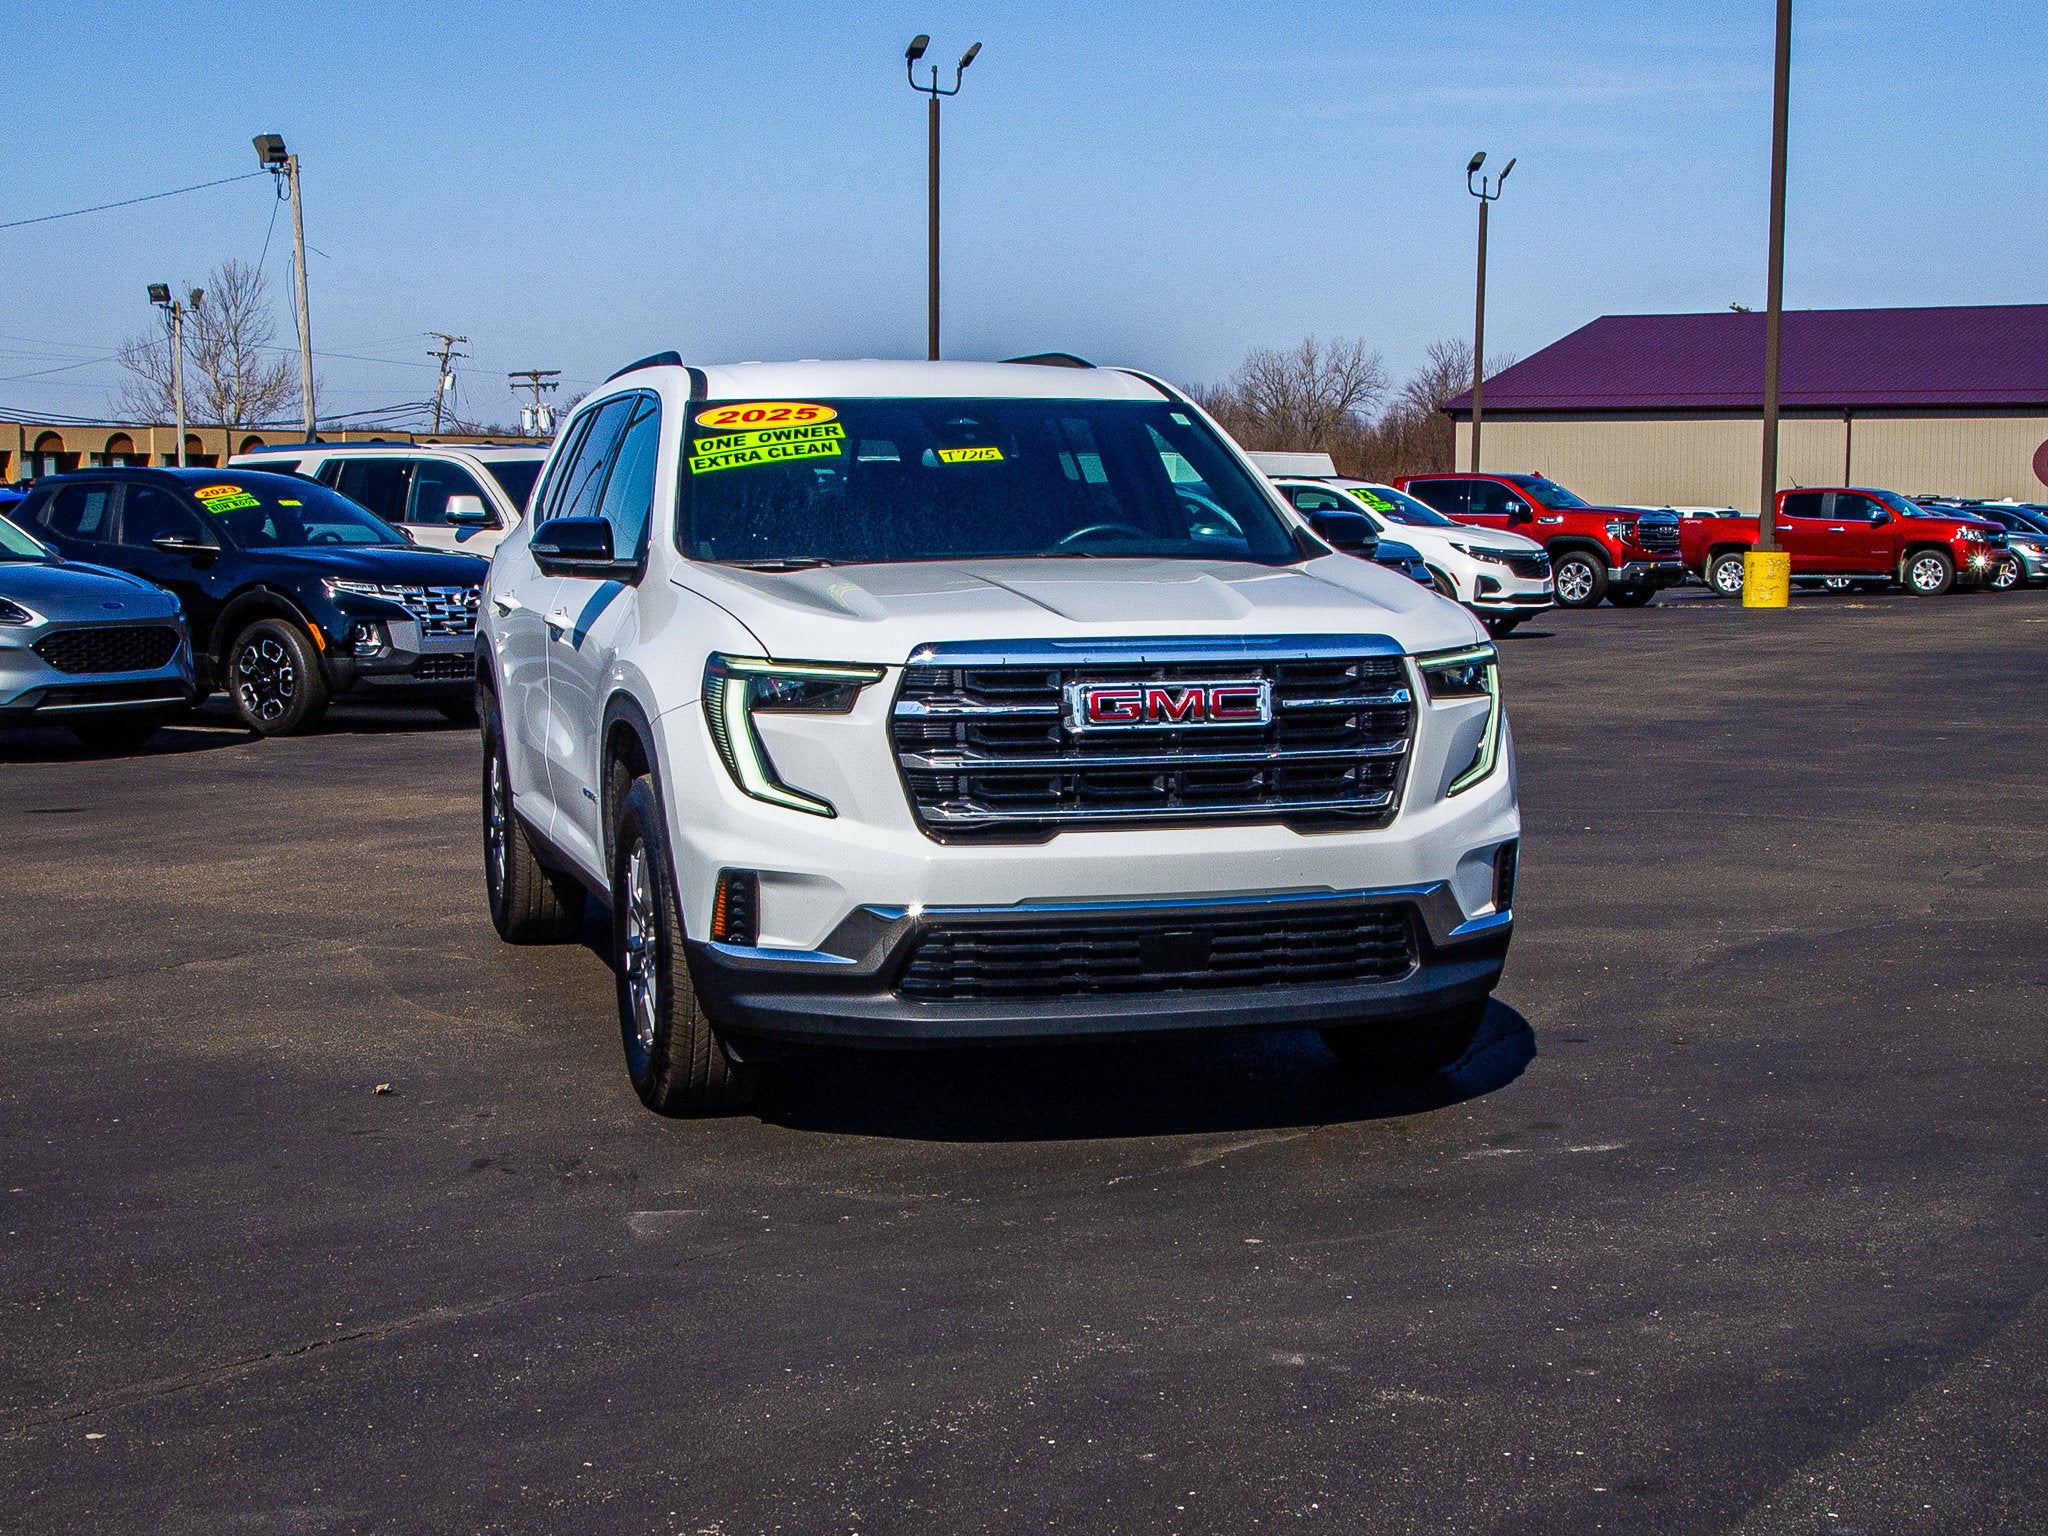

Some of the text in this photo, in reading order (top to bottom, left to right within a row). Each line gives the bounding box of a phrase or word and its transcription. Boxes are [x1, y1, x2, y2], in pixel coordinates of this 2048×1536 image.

[713, 407, 820, 425] 2025
[700, 425, 840, 452] ONE OWNER
[694, 441, 833, 471] EXTRA CLEAN
[1089, 686, 1260, 724] GMC
